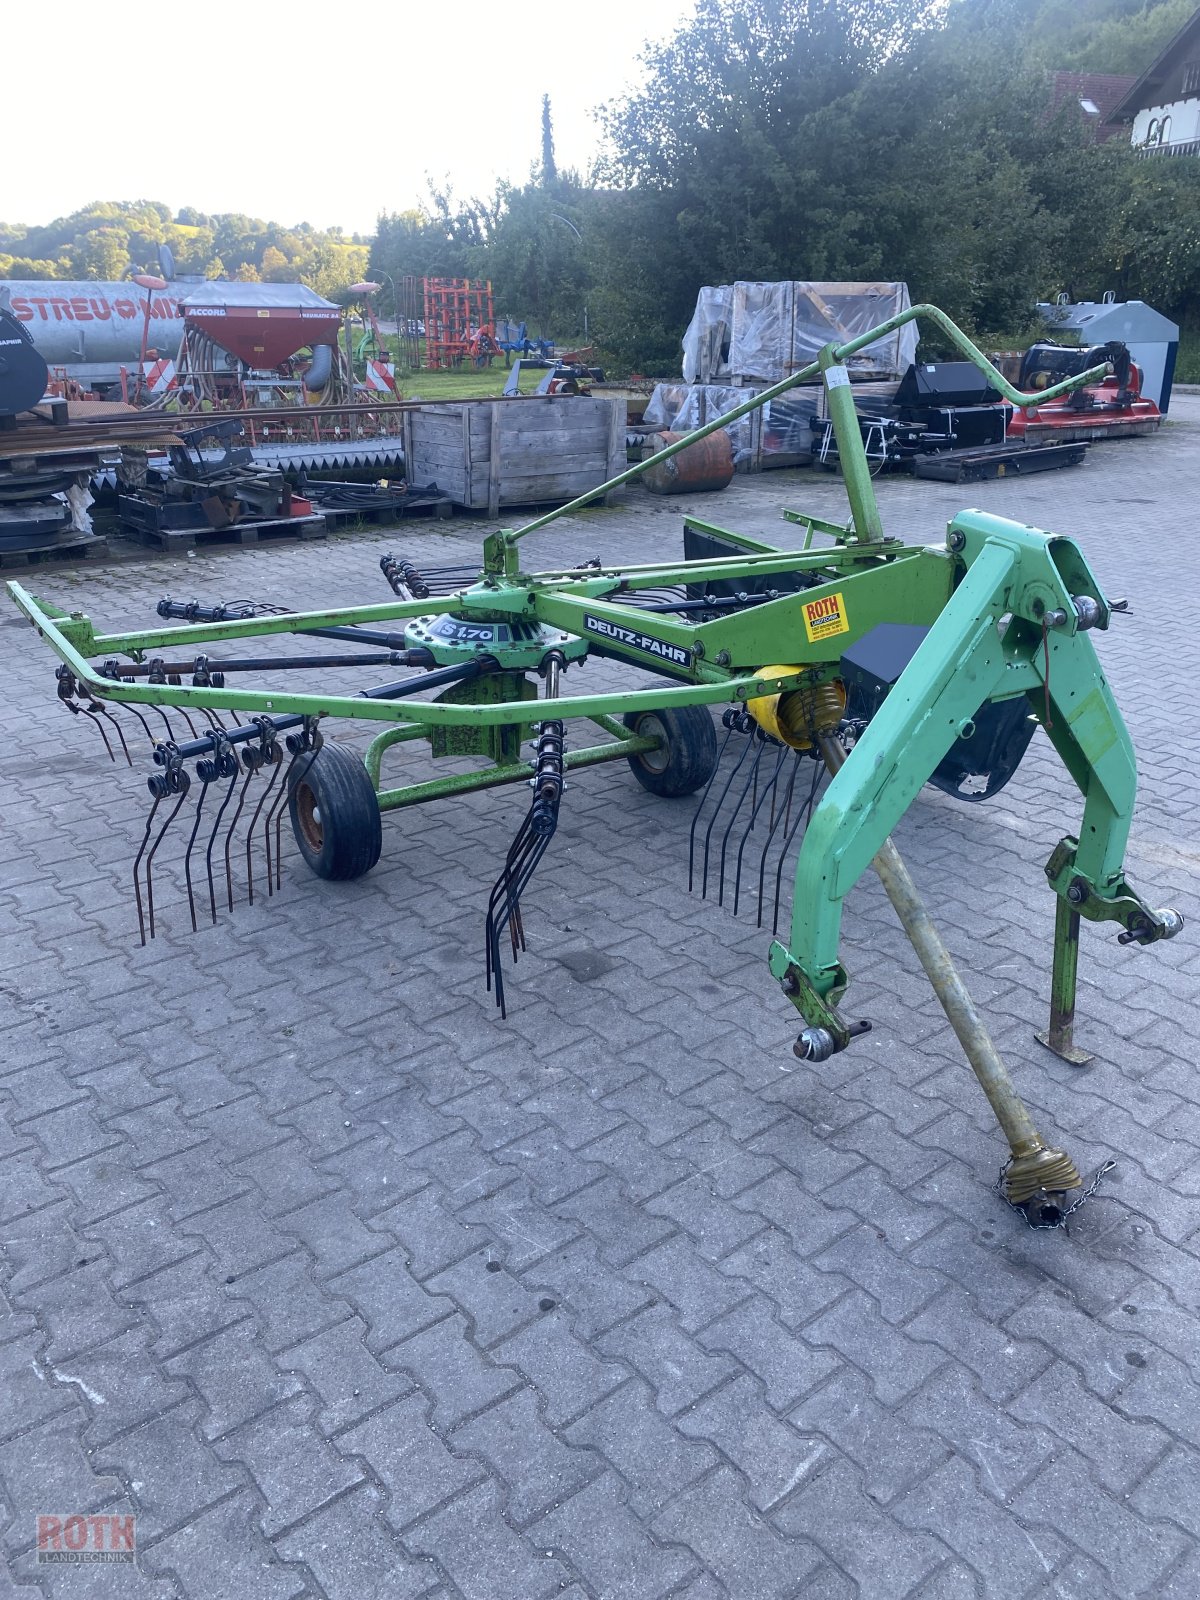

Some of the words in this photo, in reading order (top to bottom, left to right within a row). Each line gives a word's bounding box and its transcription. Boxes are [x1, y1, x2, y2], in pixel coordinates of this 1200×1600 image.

[11, 297, 111, 320] STREU
[188, 308, 227, 317] ACCORD
[806, 595, 839, 621] ROTH
[440, 622, 457, 635] S
[456, 626, 493, 640] 1.70
[587, 617, 687, 663] DEUTZ-FAHR
